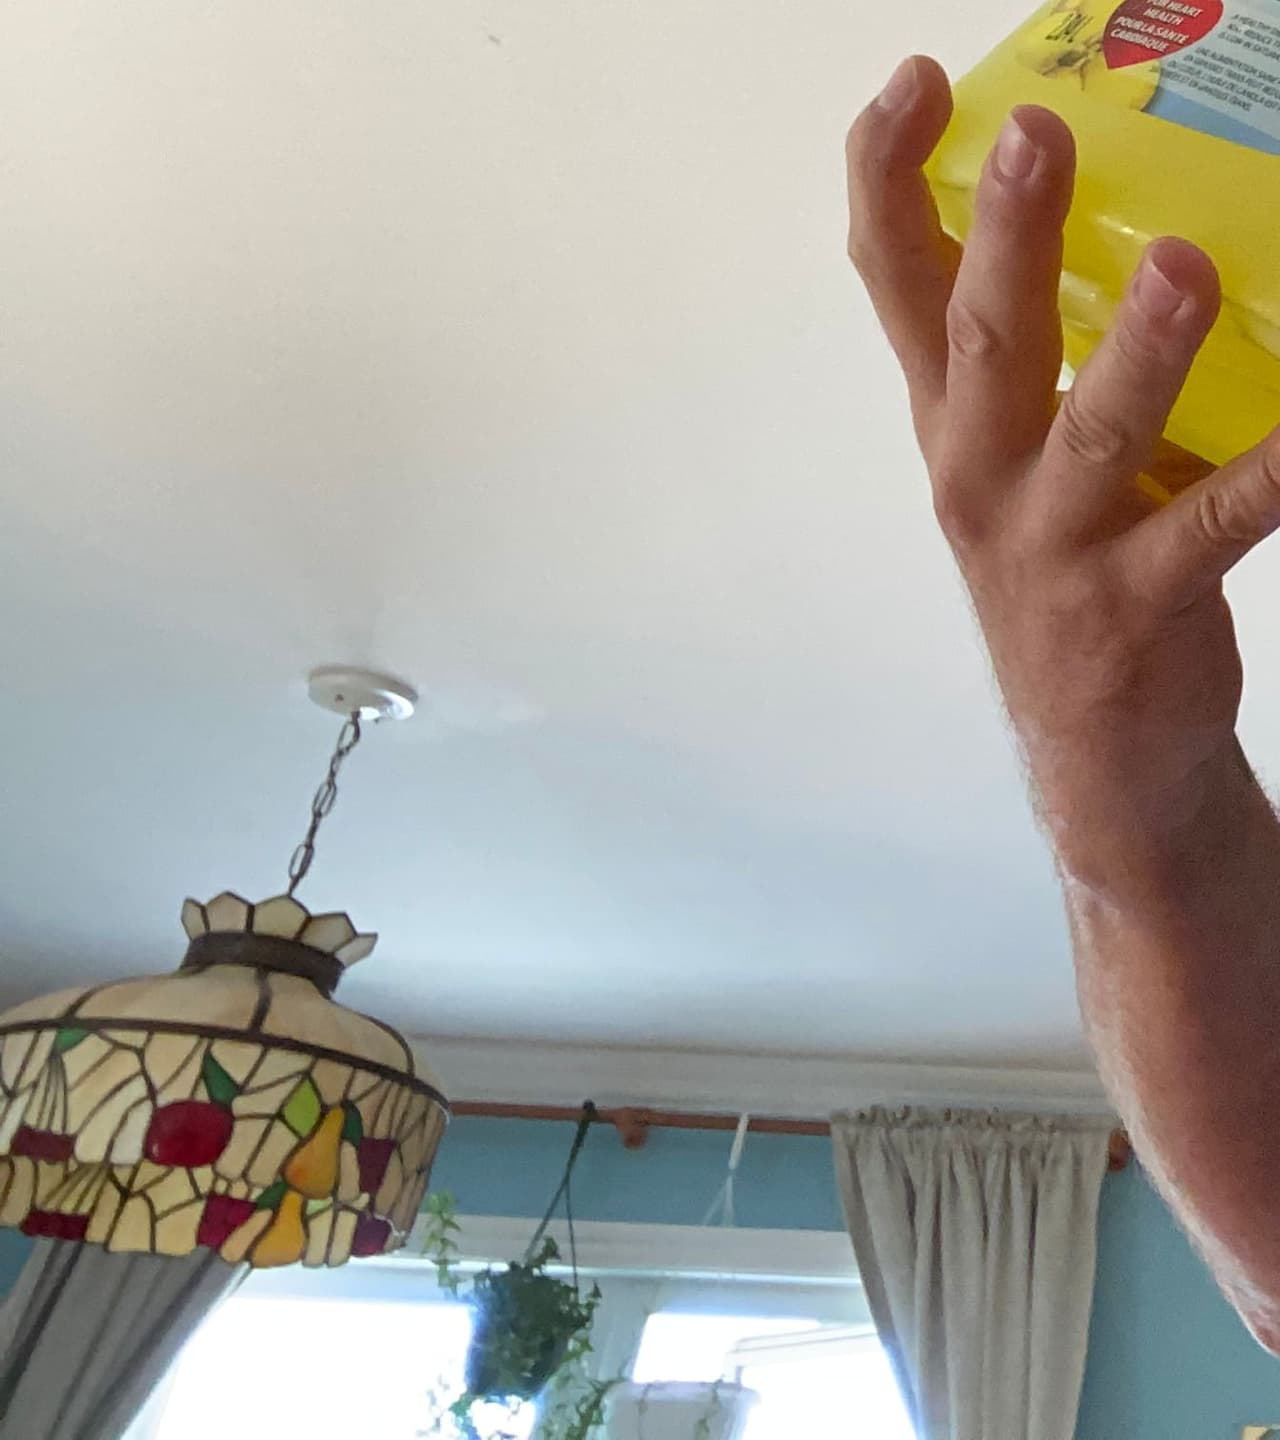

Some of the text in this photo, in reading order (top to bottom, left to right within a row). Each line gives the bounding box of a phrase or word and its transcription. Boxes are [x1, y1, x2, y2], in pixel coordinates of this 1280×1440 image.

[1143, 7, 1185, 26] HEALTH
[1166, 0, 1205, 18] HEART
[1114, 16, 1145, 31] POUR
[1140, 22, 1157, 34] LA
[1109, 28, 1170, 53] CARDIAQUE
